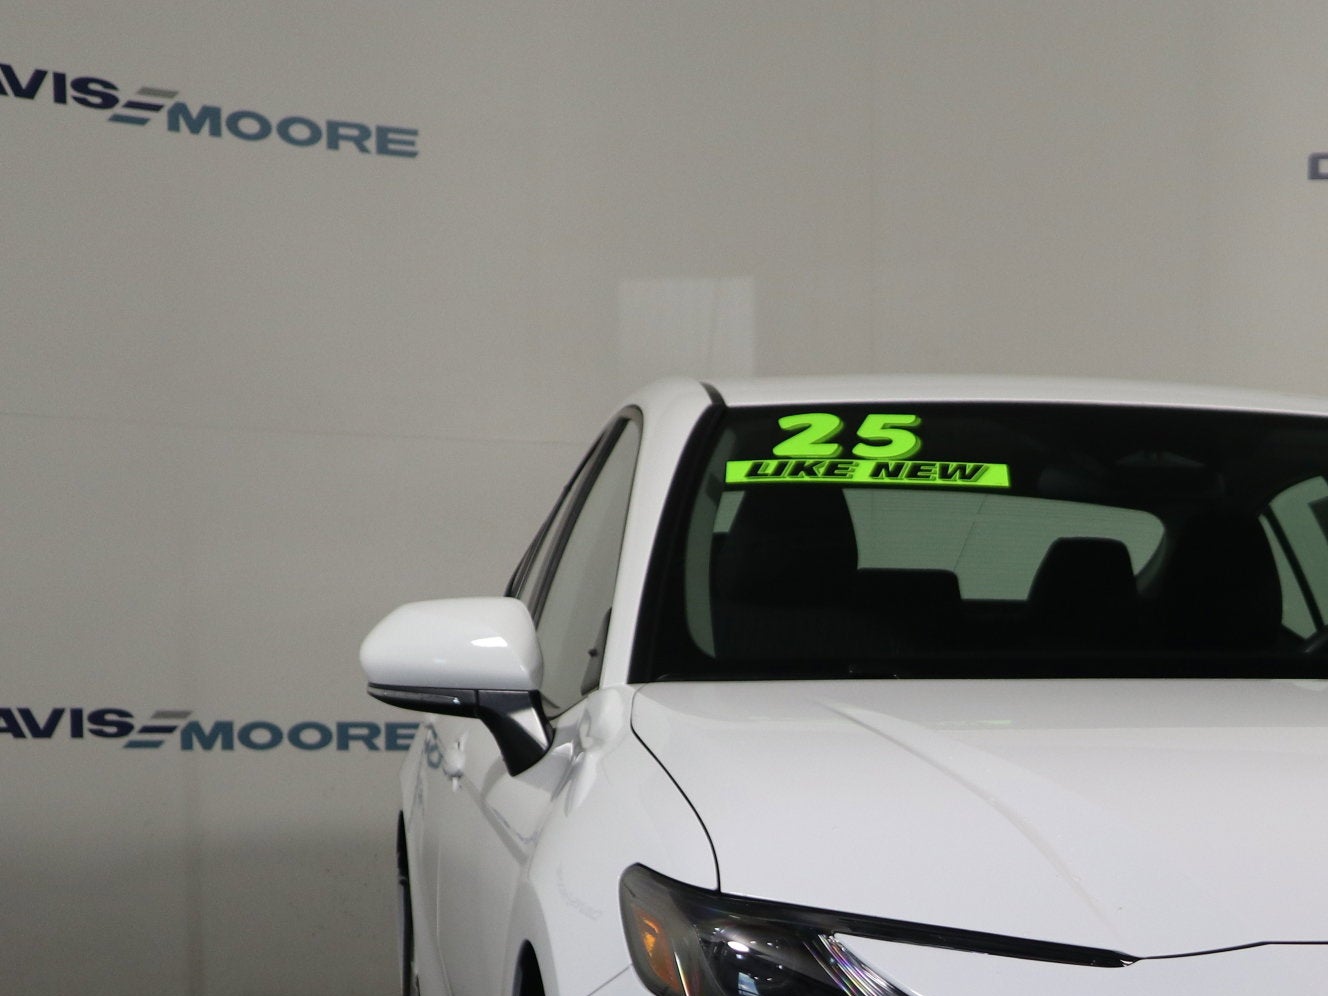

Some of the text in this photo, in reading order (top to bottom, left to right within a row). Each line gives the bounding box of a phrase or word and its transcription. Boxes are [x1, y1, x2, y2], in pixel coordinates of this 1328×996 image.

[0, 63, 419, 158] VIS MOORE
[772, 412, 922, 459] 25
[744, 460, 988, 482] LIKE NEW
[180, 720, 420, 751] MOORE
